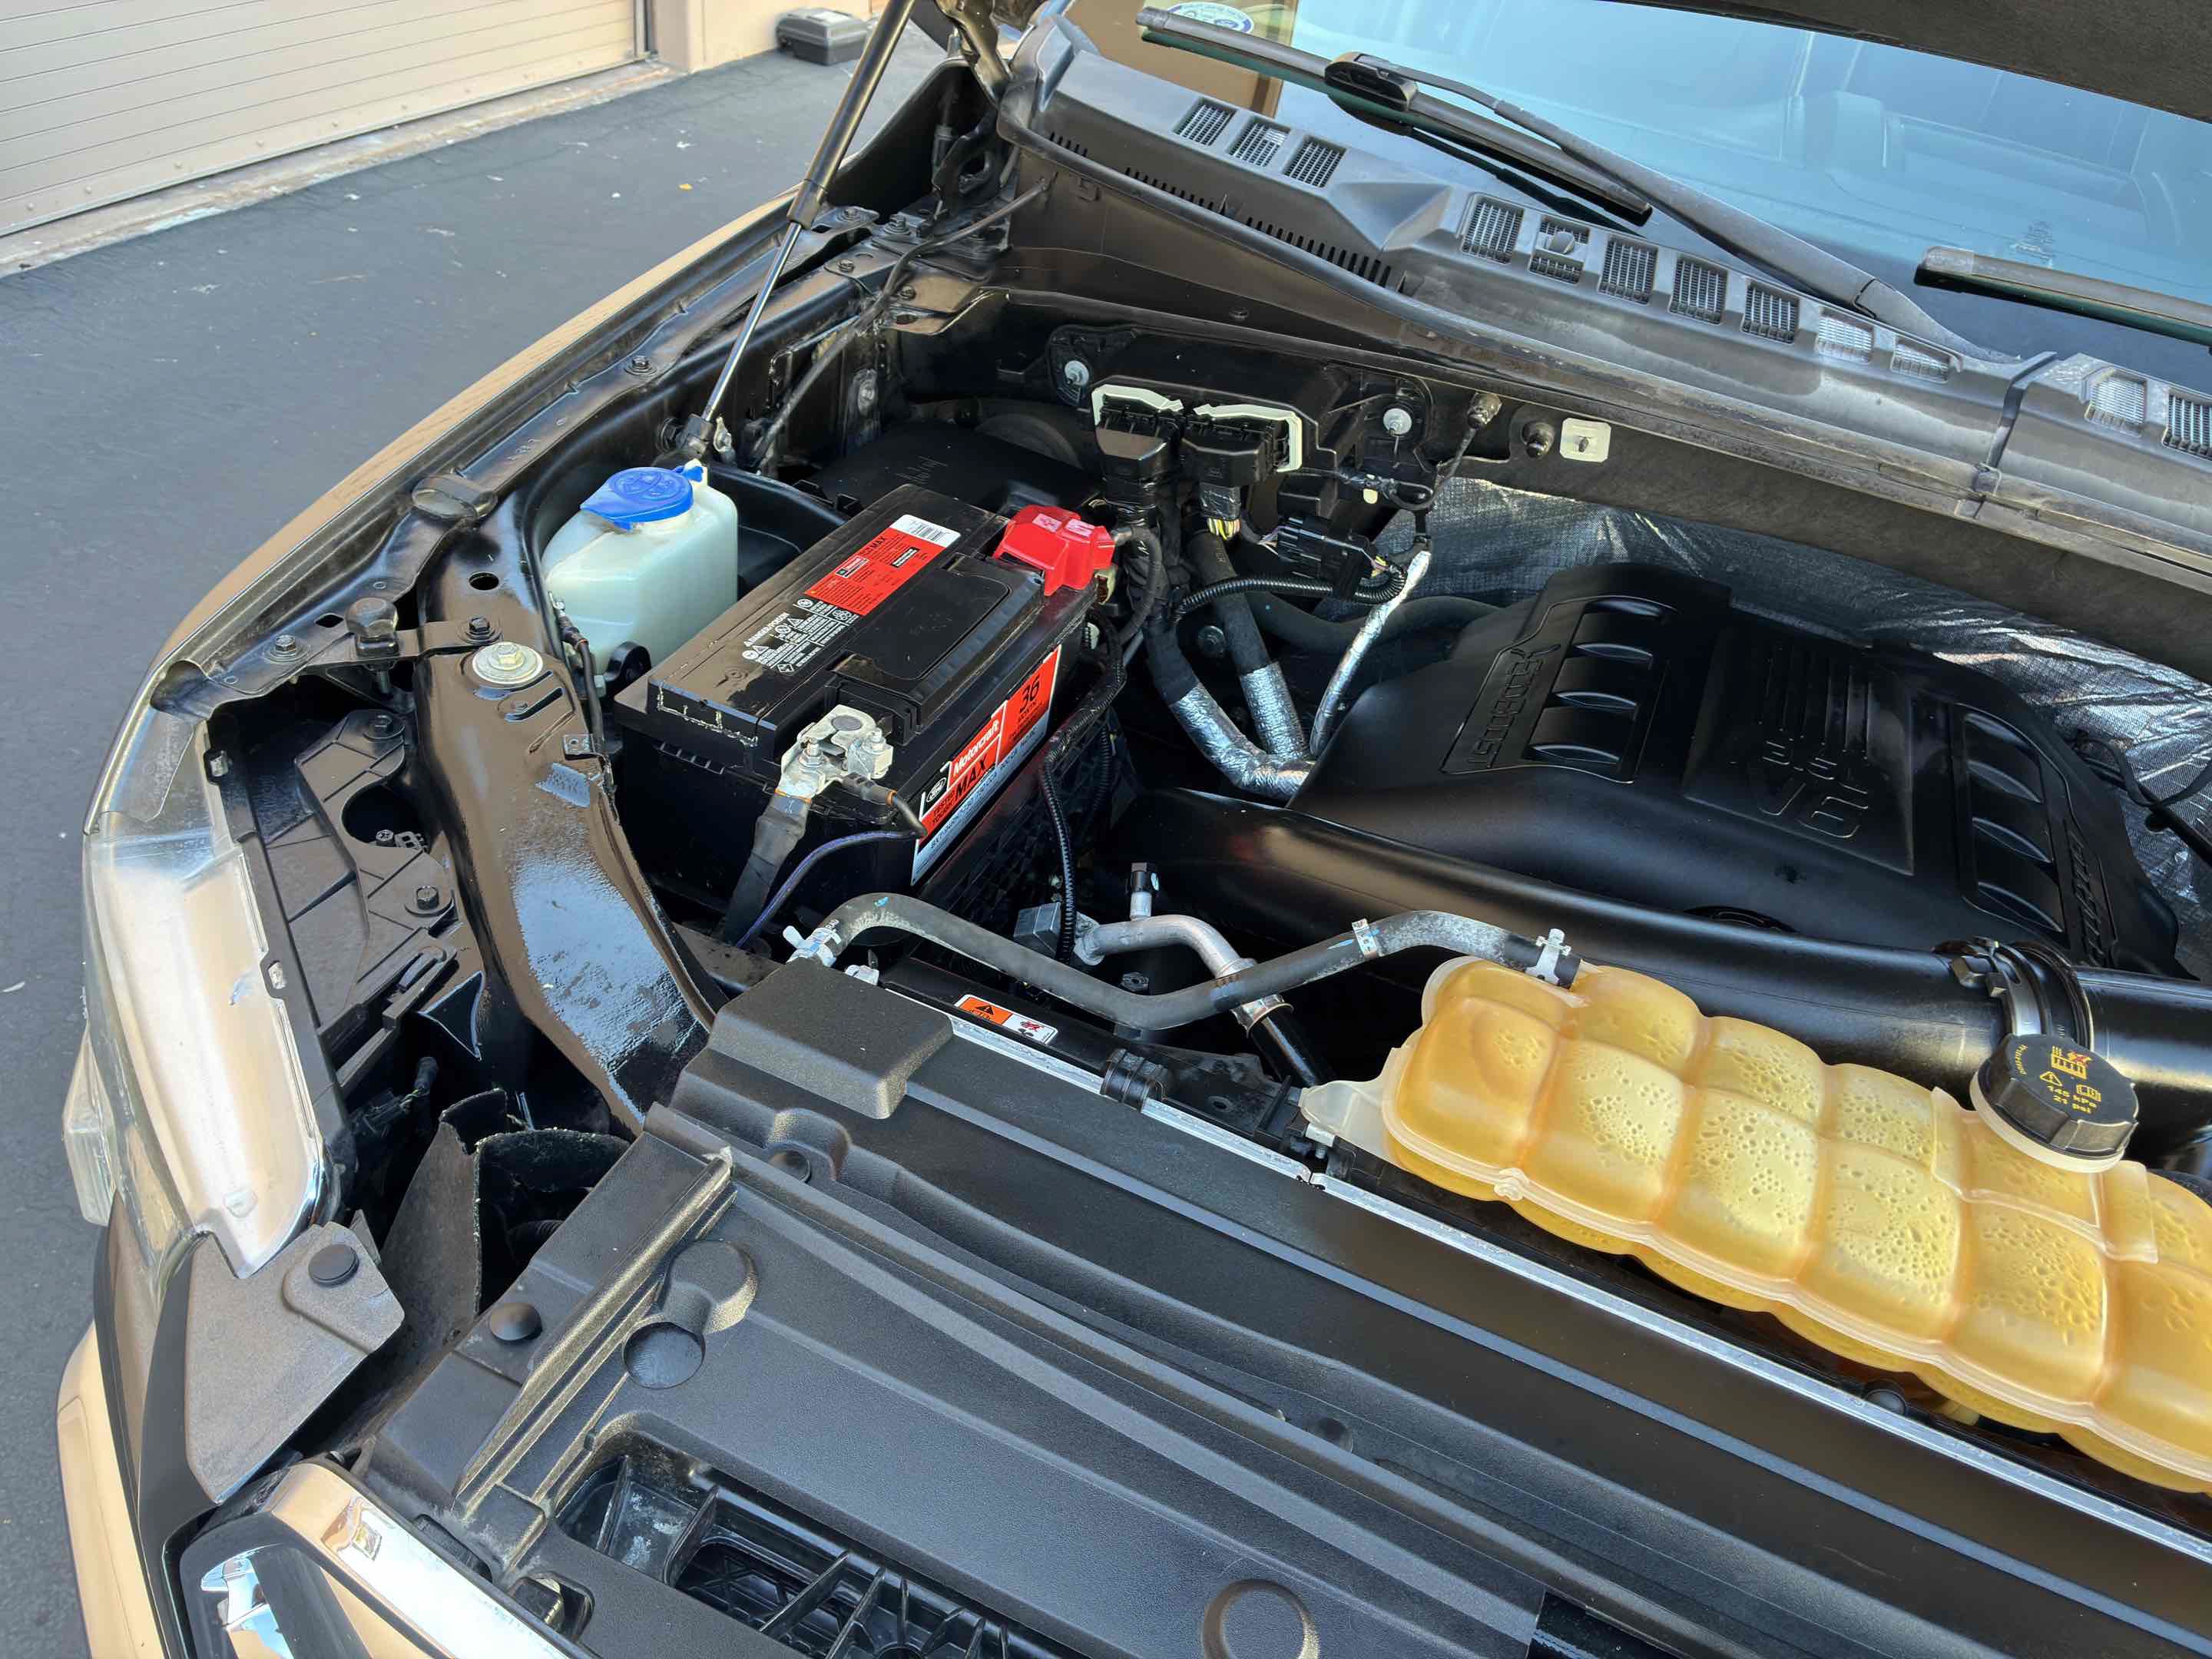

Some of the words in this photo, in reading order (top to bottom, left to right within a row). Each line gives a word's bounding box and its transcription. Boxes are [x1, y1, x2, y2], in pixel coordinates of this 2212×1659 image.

[1018, 674, 1040, 713] 36
[952, 720, 999, 777] Motorcraft
[955, 755, 988, 802] MAX
[2047, 1084, 2071, 1098] 145
[2073, 1094, 2098, 1109] kPa
[2053, 1094, 2068, 1104] 21
[2071, 1103, 2091, 1114] psi
